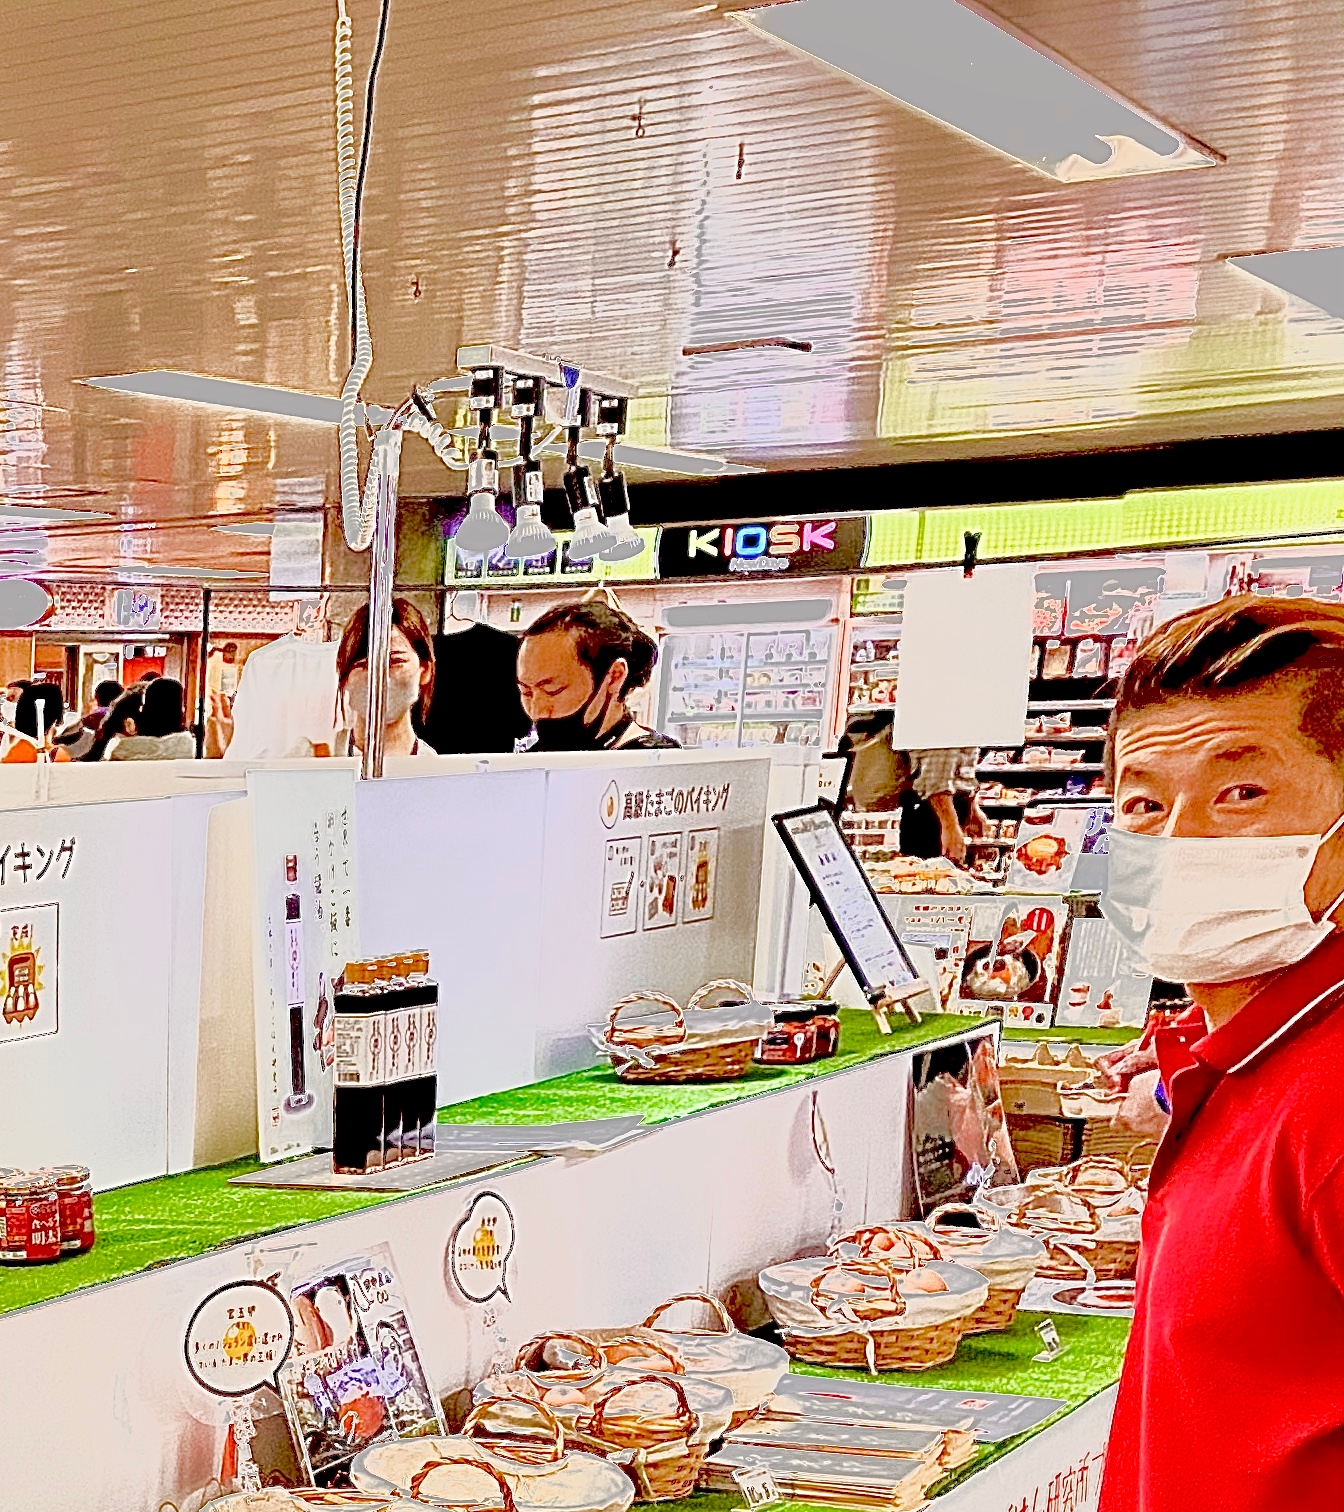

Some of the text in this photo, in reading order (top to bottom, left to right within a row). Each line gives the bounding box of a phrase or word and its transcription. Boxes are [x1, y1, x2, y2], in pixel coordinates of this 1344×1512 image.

[688, 521, 837, 558] KIOSK
[622, 782, 731, 821] 高級たまごのバイキング
